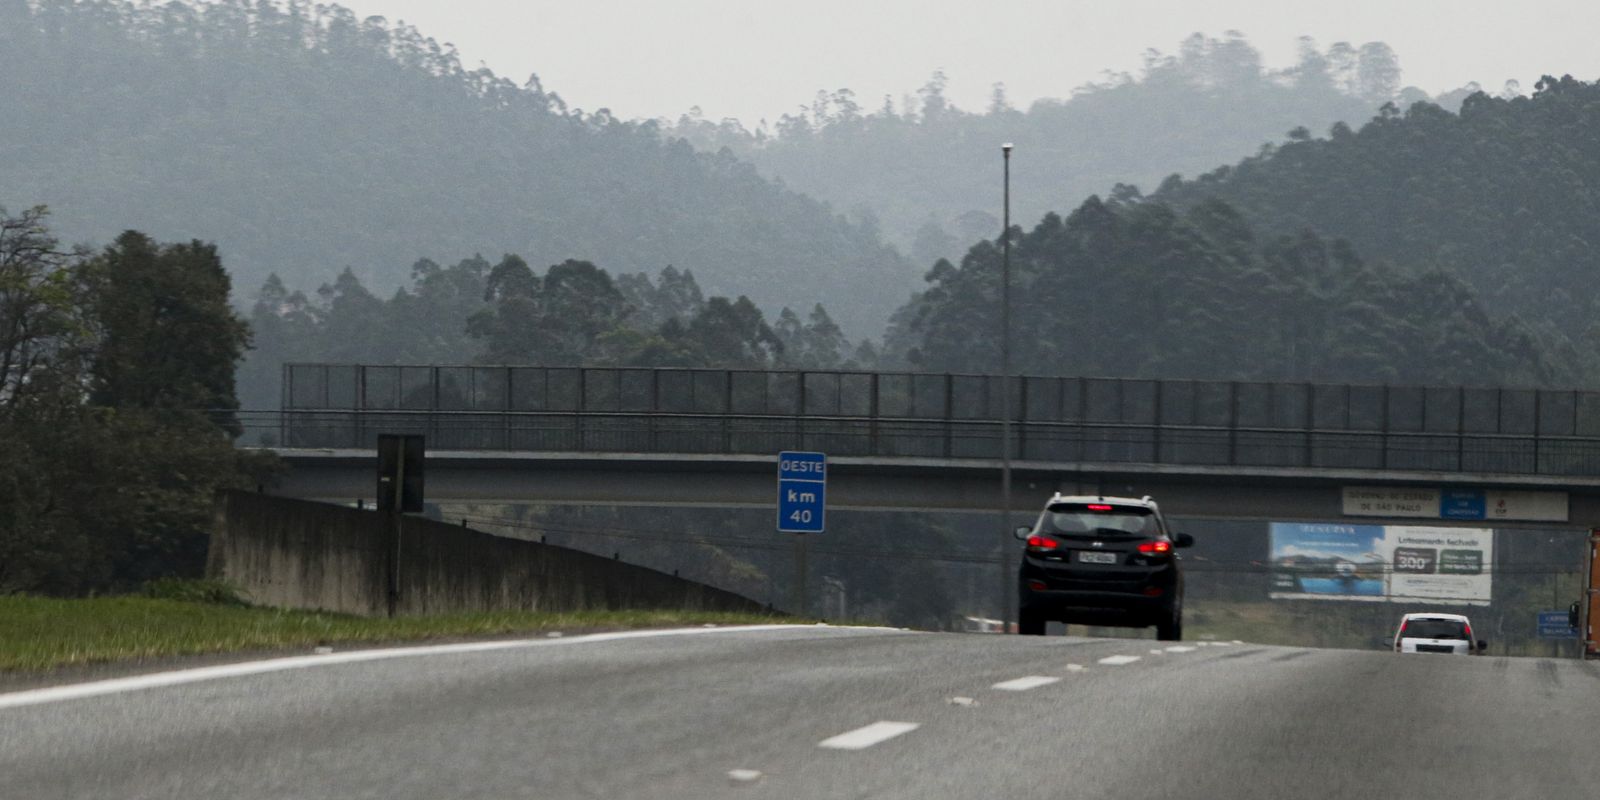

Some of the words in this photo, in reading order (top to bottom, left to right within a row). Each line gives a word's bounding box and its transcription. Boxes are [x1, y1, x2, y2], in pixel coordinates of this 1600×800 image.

[781, 460, 824, 473] OESTE
[788, 489, 816, 503] km
[1395, 503, 1422, 512] PAULO
[790, 509, 812, 523] 40
